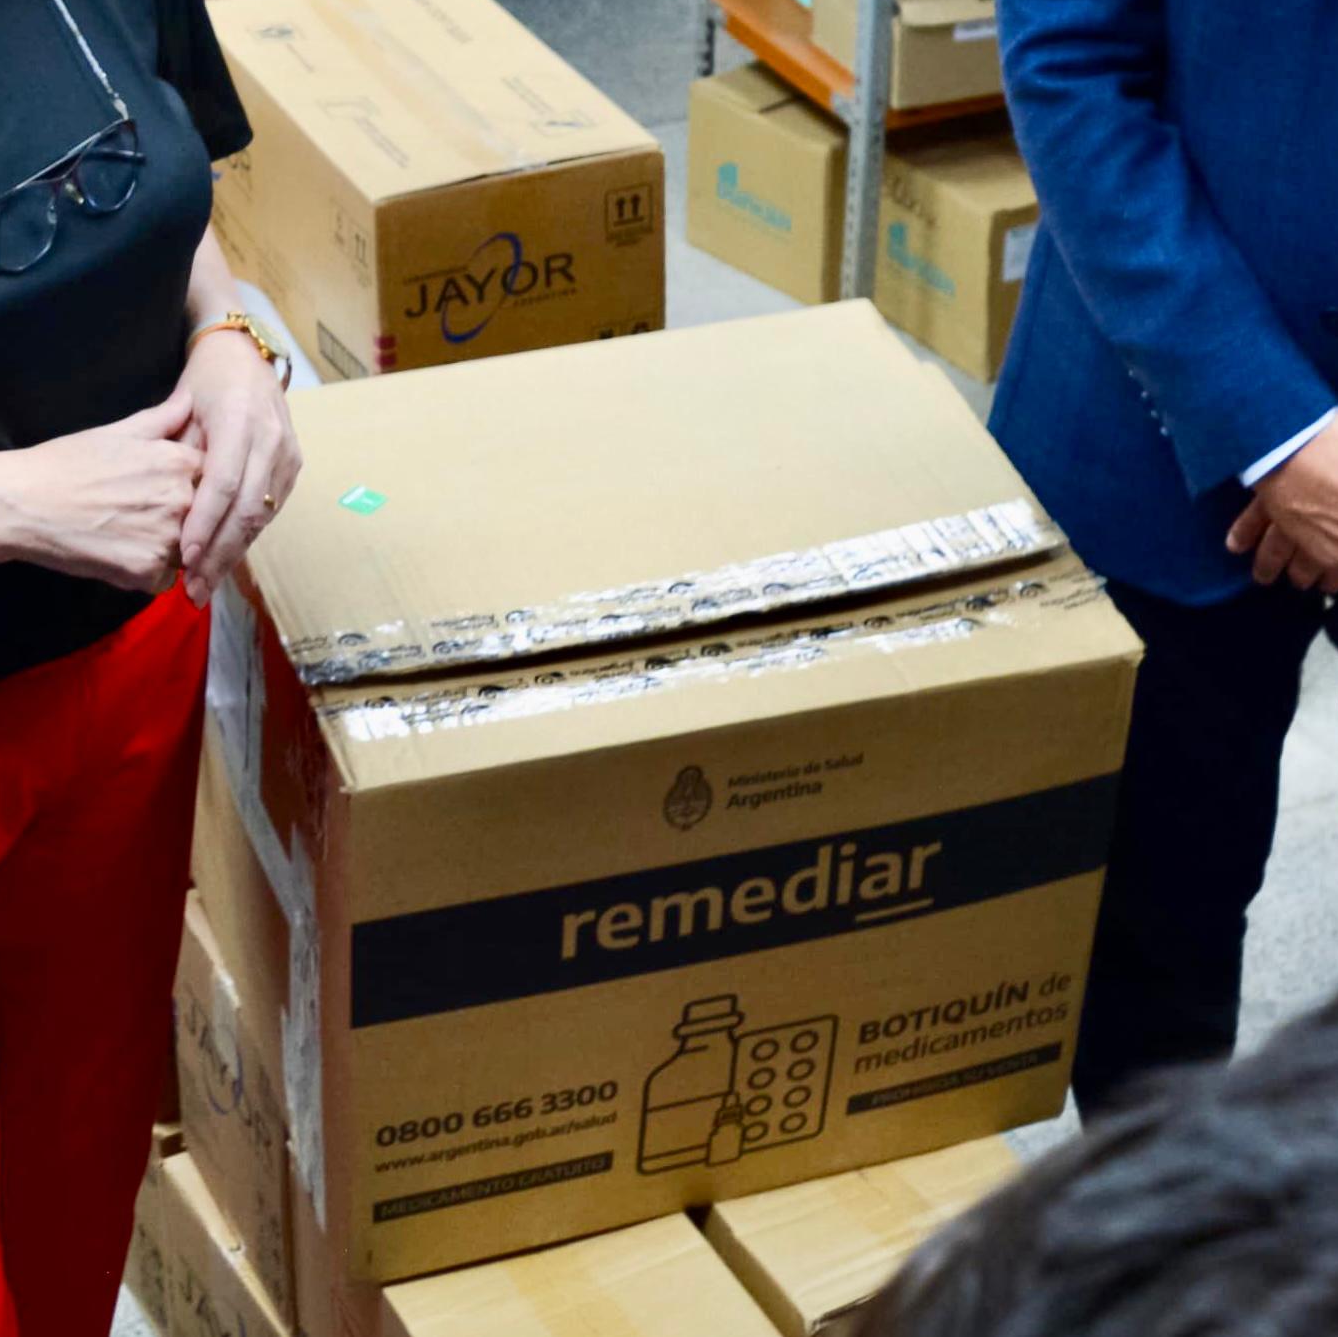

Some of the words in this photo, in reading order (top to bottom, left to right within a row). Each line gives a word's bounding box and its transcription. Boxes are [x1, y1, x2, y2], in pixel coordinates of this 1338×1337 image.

[404, 252, 577, 319] JAYOR
[725, 779, 824, 810] Argentina
[727, 766, 801, 789] Ministerio
[804, 759, 823, 775] de
[824, 751, 864, 771] Salud
[561, 840, 943, 961] remediar
[853, 1002, 1069, 1076] medicamentos
[858, 979, 1030, 1046] BOTIQUÍN
[1038, 971, 1072, 998] de
[375, 1112, 464, 1148] 0800
[471, 1101, 534, 1128] 666
[540, 1080, 619, 1114] 3300
